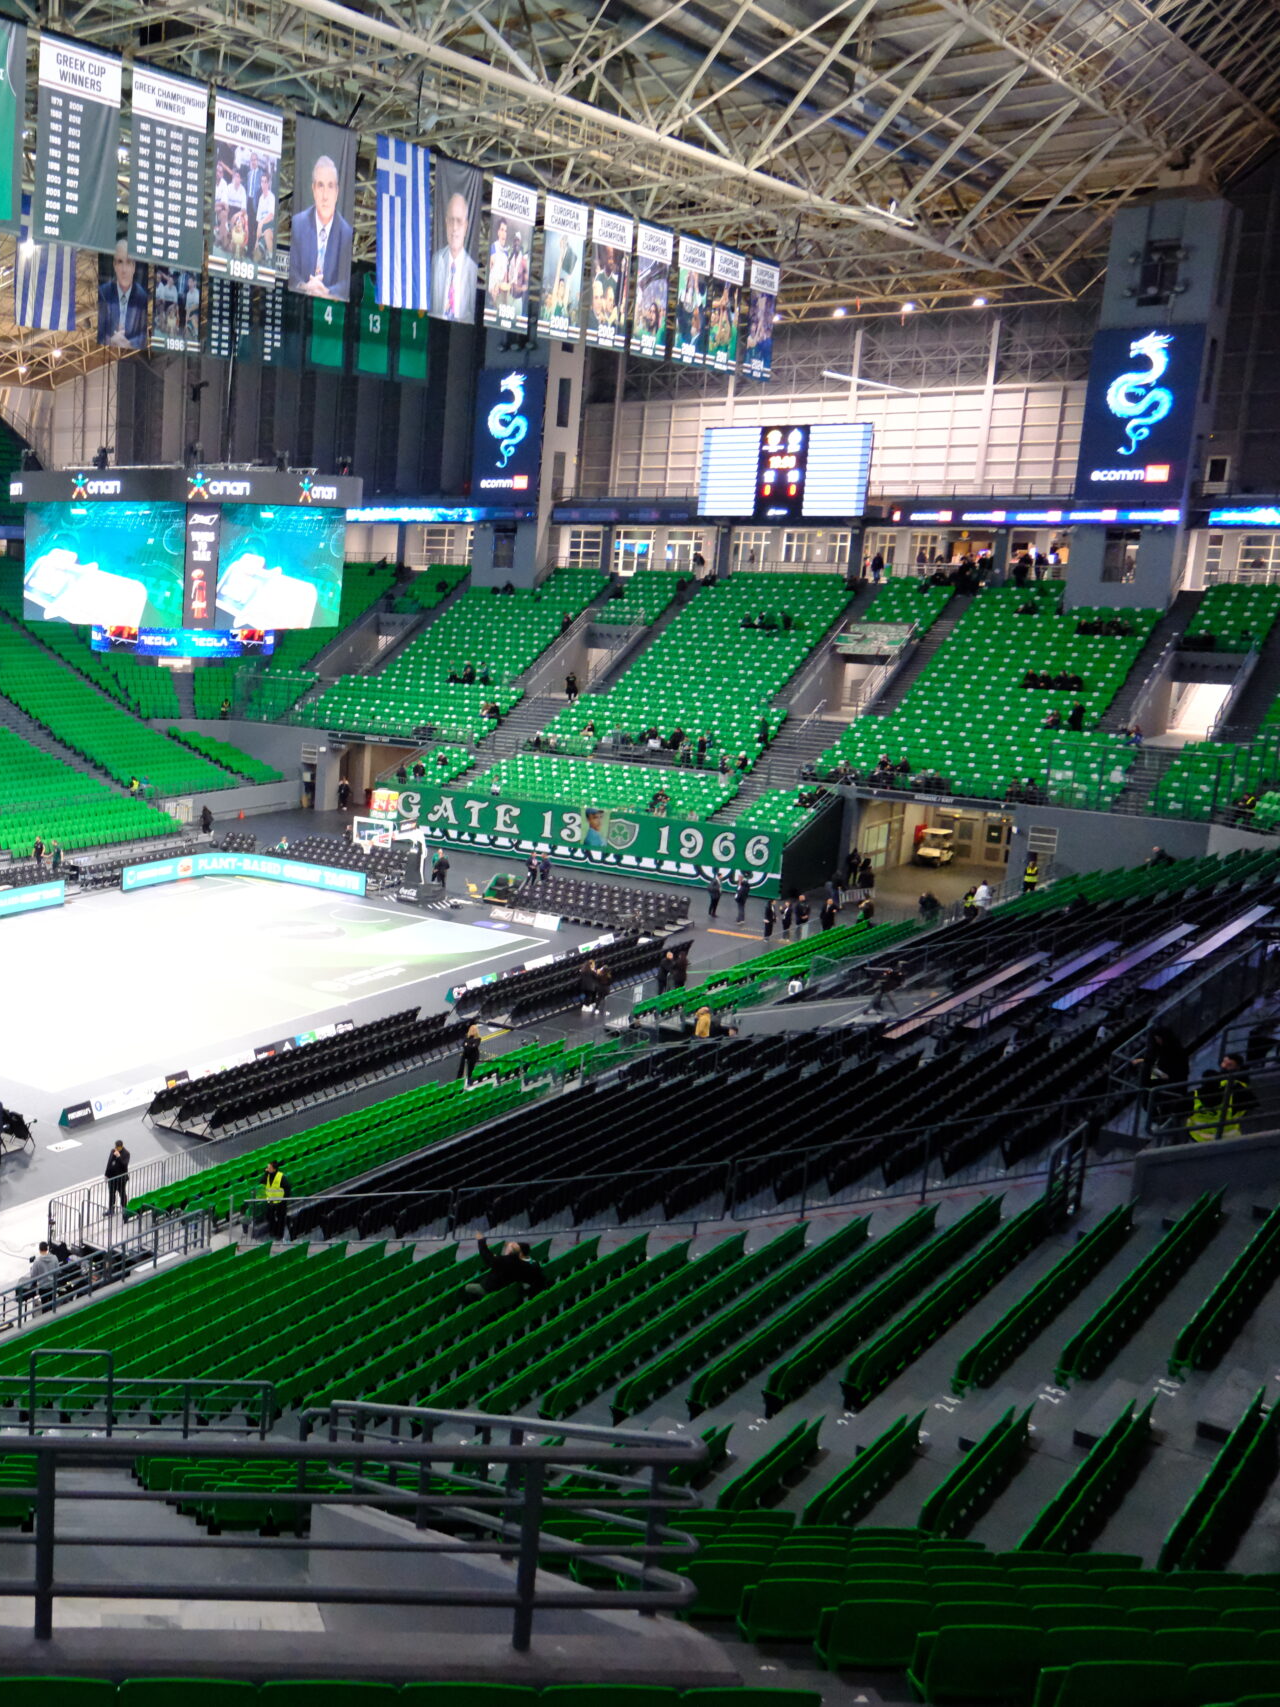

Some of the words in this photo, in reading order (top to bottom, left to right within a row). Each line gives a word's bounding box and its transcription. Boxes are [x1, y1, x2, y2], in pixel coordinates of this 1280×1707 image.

[56, 52, 86, 72] GREEK
[88, 63, 106, 79] CUP
[59, 69, 102, 93] WINNERS
[135, 80, 156, 96] GREEK
[157, 86, 206, 109] CHAMPIONSHIP
[155, 99, 186, 116] WINNERS
[217, 108, 280, 136] INTERCONTINENTAL
[225, 122, 240, 135] CUP
[241, 126, 271, 145] WINNERS
[501, 187, 529, 205] EUROPEAN
[497, 198, 530, 217] CHAMPIONS
[554, 204, 579, 221] EUROPEAN
[551, 214, 581, 232] CHAMPIONS
[229, 259, 255, 280] 1996
[324, 306, 332, 325] 4
[369, 314, 381, 334] 13
[412, 321, 417, 340] 1
[166, 338, 185, 351] 1996
[398, 791, 520, 834] GATE
[541, 810, 582, 842] 13
[656, 825, 770, 866] 1966
[934, 1396, 962, 1413] 24
[1039, 1385, 1066, 1405] 25
